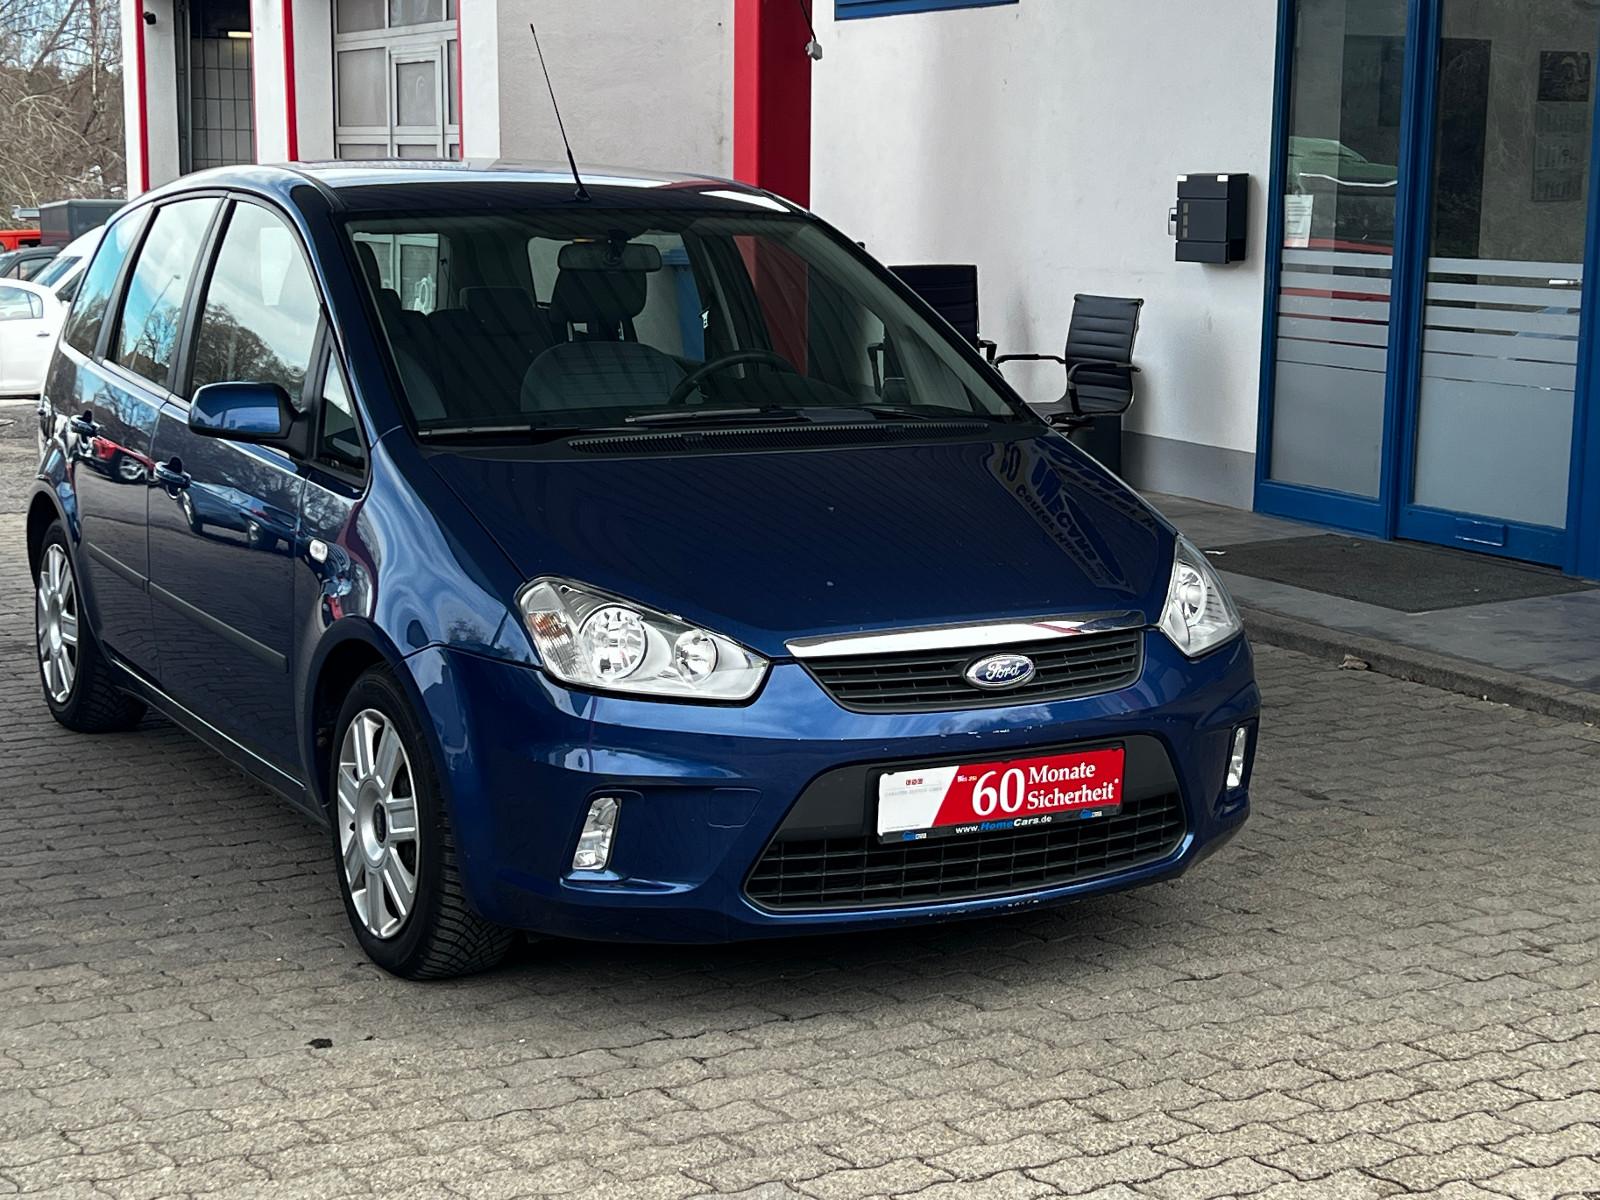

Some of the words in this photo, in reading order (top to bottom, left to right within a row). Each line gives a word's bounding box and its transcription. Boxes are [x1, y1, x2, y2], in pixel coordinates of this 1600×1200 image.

[986, 660, 1025, 680] Ford
[1028, 761, 1096, 785] Monate
[972, 768, 1026, 817] 60
[955, 814, 1053, 834] www.HomeCars.de
